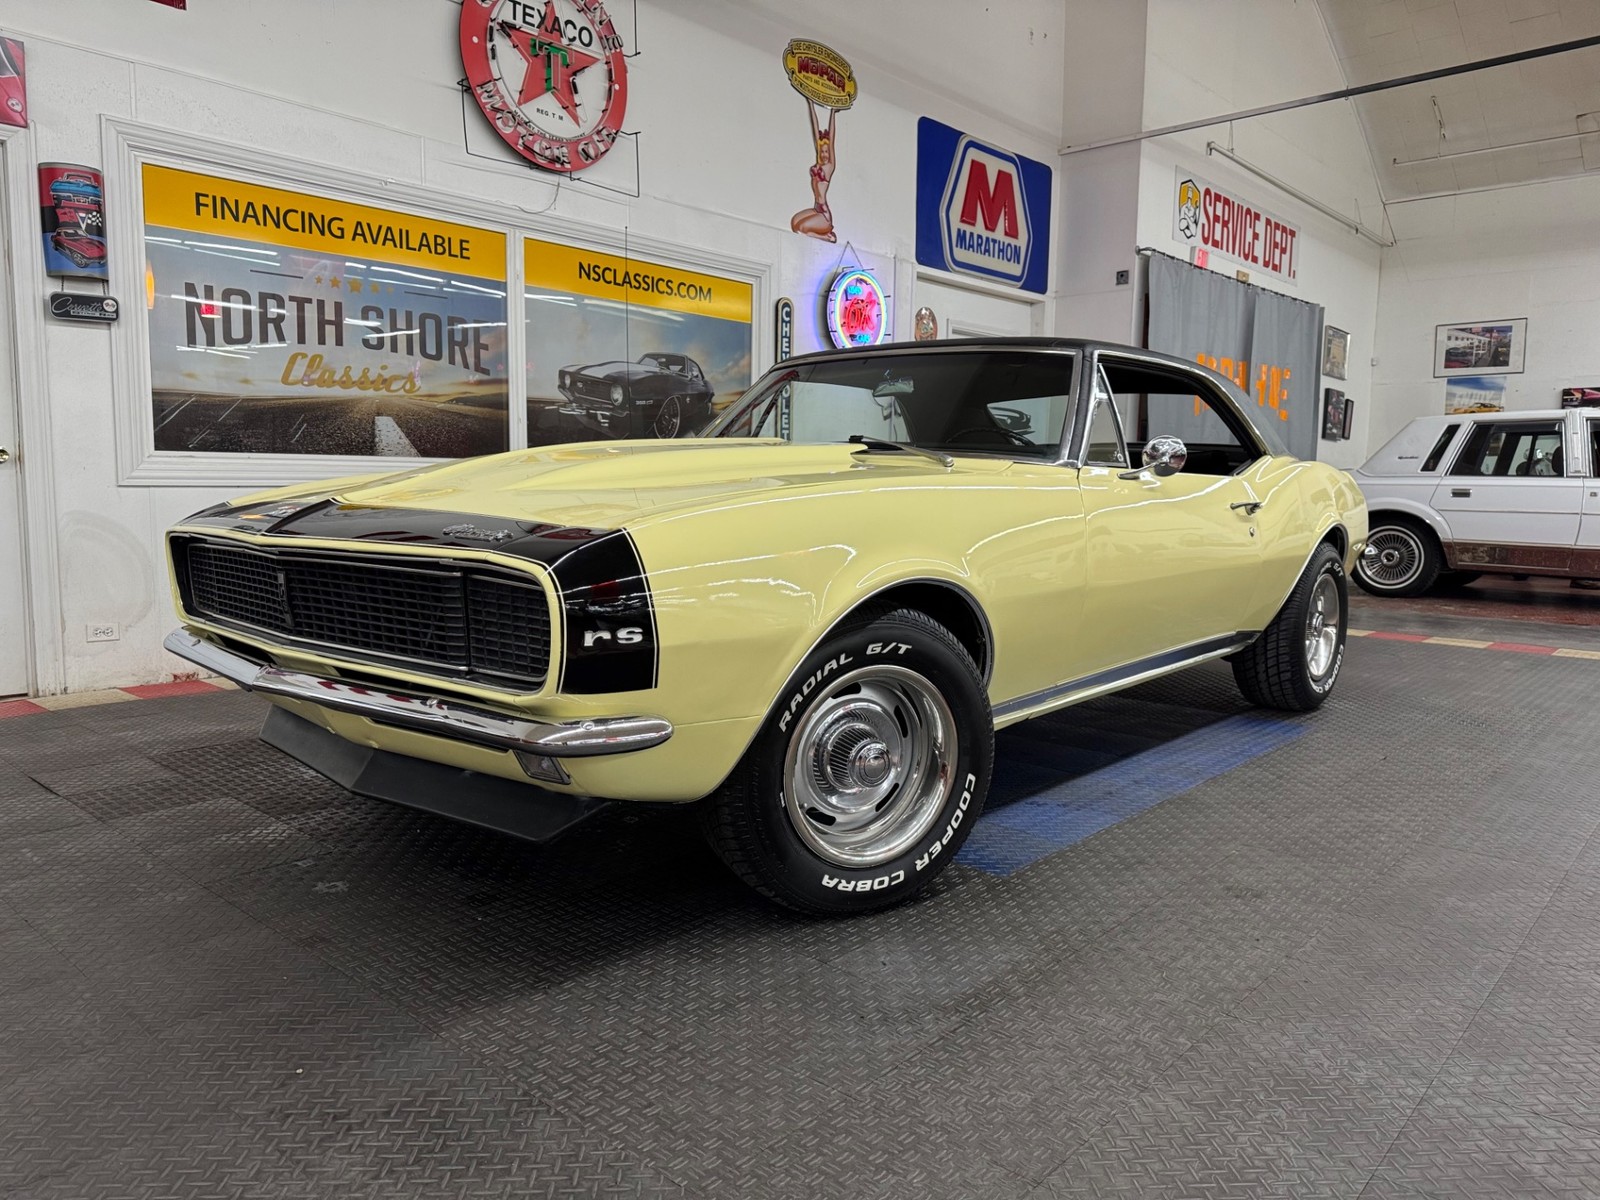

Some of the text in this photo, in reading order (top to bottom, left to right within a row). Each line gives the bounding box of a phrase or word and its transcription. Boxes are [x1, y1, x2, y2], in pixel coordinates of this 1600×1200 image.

[508, 0, 593, 48] TEXACO
[797, 56, 846, 93] MOPAR
[194, 191, 471, 260] FINANCING AVAILABLE
[960, 159, 1019, 241] M
[1201, 187, 1297, 279] SERVICE DEPT.
[578, 261, 712, 303] NSCLASSICS.COM
[955, 228, 1021, 265] MARATHON
[184, 281, 491, 376] NORTH SHORE
[280, 351, 422, 394] Classics
[782, 306, 791, 441] CHEVOLET
[778, 642, 912, 733] RADIAL G/T
[821, 773, 976, 892] COOPER COBRA
